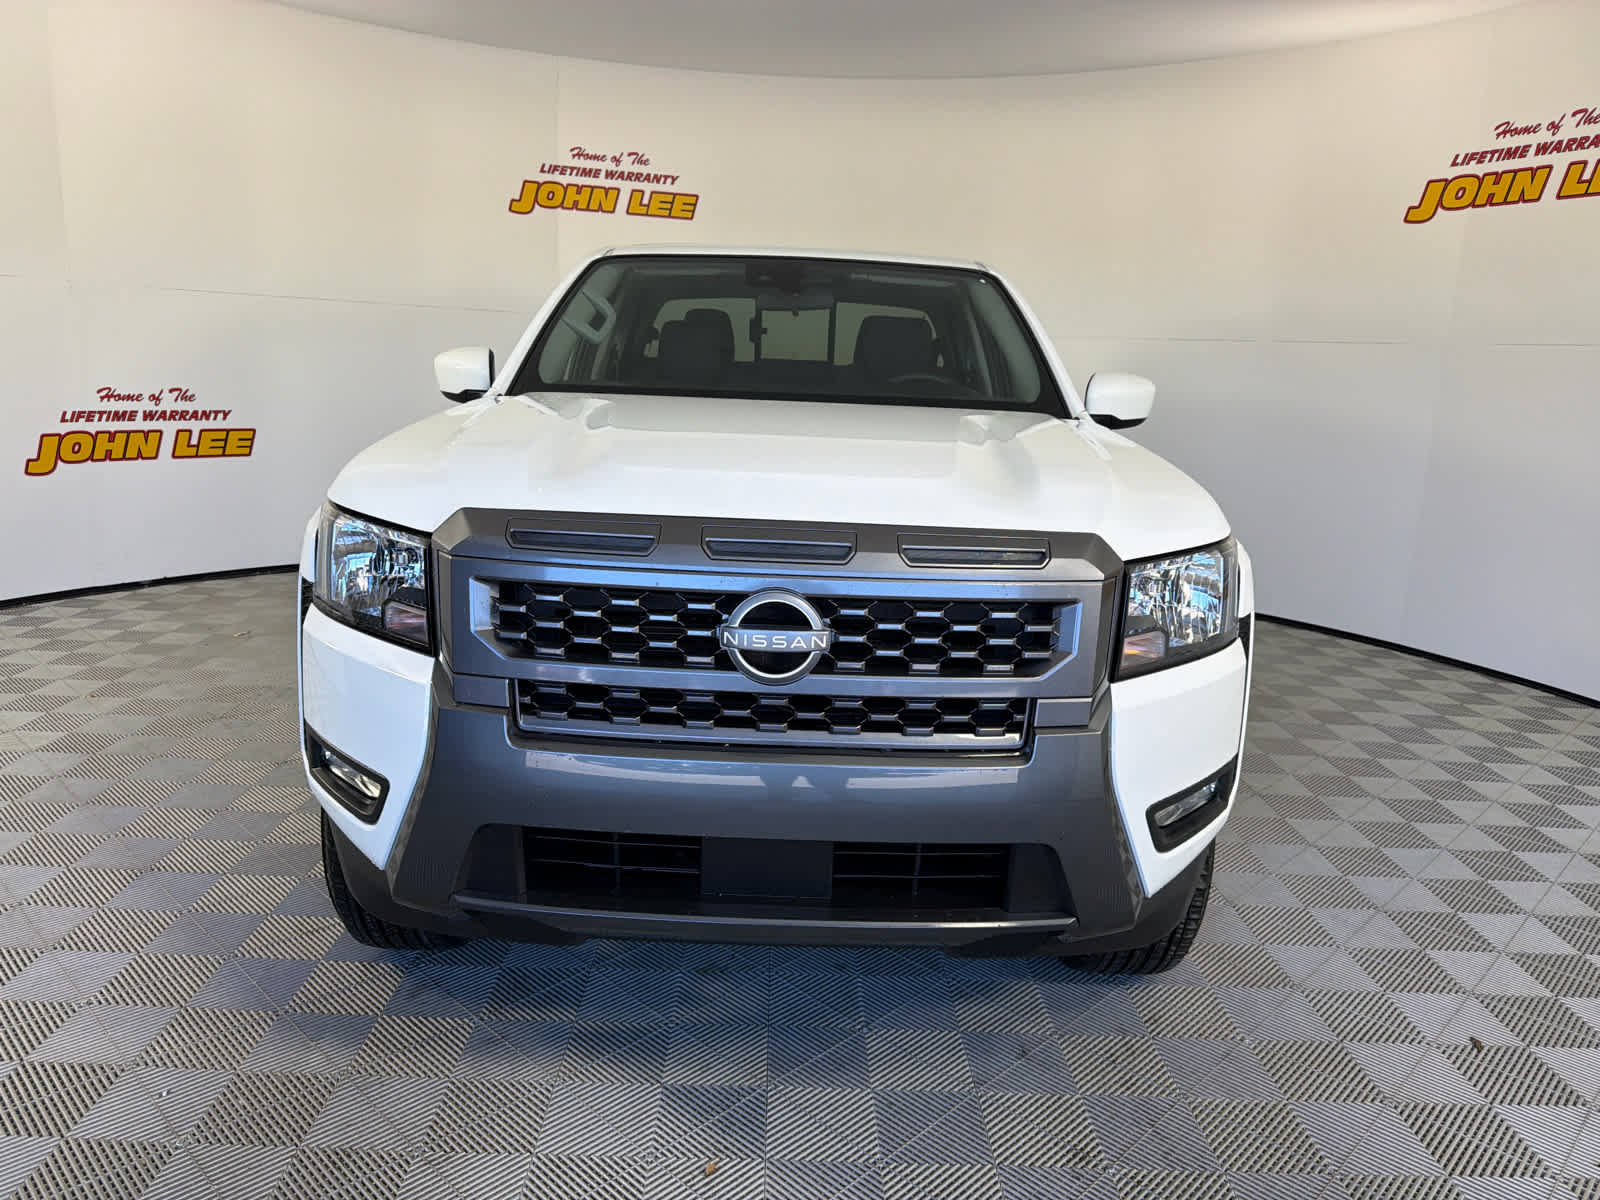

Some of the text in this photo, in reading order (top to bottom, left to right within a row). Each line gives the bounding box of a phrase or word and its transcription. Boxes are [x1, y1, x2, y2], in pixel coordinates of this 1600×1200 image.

[1494, 107, 1600, 140] Home of The
[570, 146, 650, 167] Home of The
[1450, 144, 1533, 167] LIFETIME
[539, 163, 679, 185] LIFETIME WARRANTY
[509, 179, 699, 220] JOHN LEE
[1403, 164, 1553, 224] JOHN
[96, 387, 196, 406] Home of The
[60, 409, 232, 423] LIFETIME WARRANTY
[25, 428, 256, 476] JOHN LEE
[723, 631, 827, 649] NISSAN
